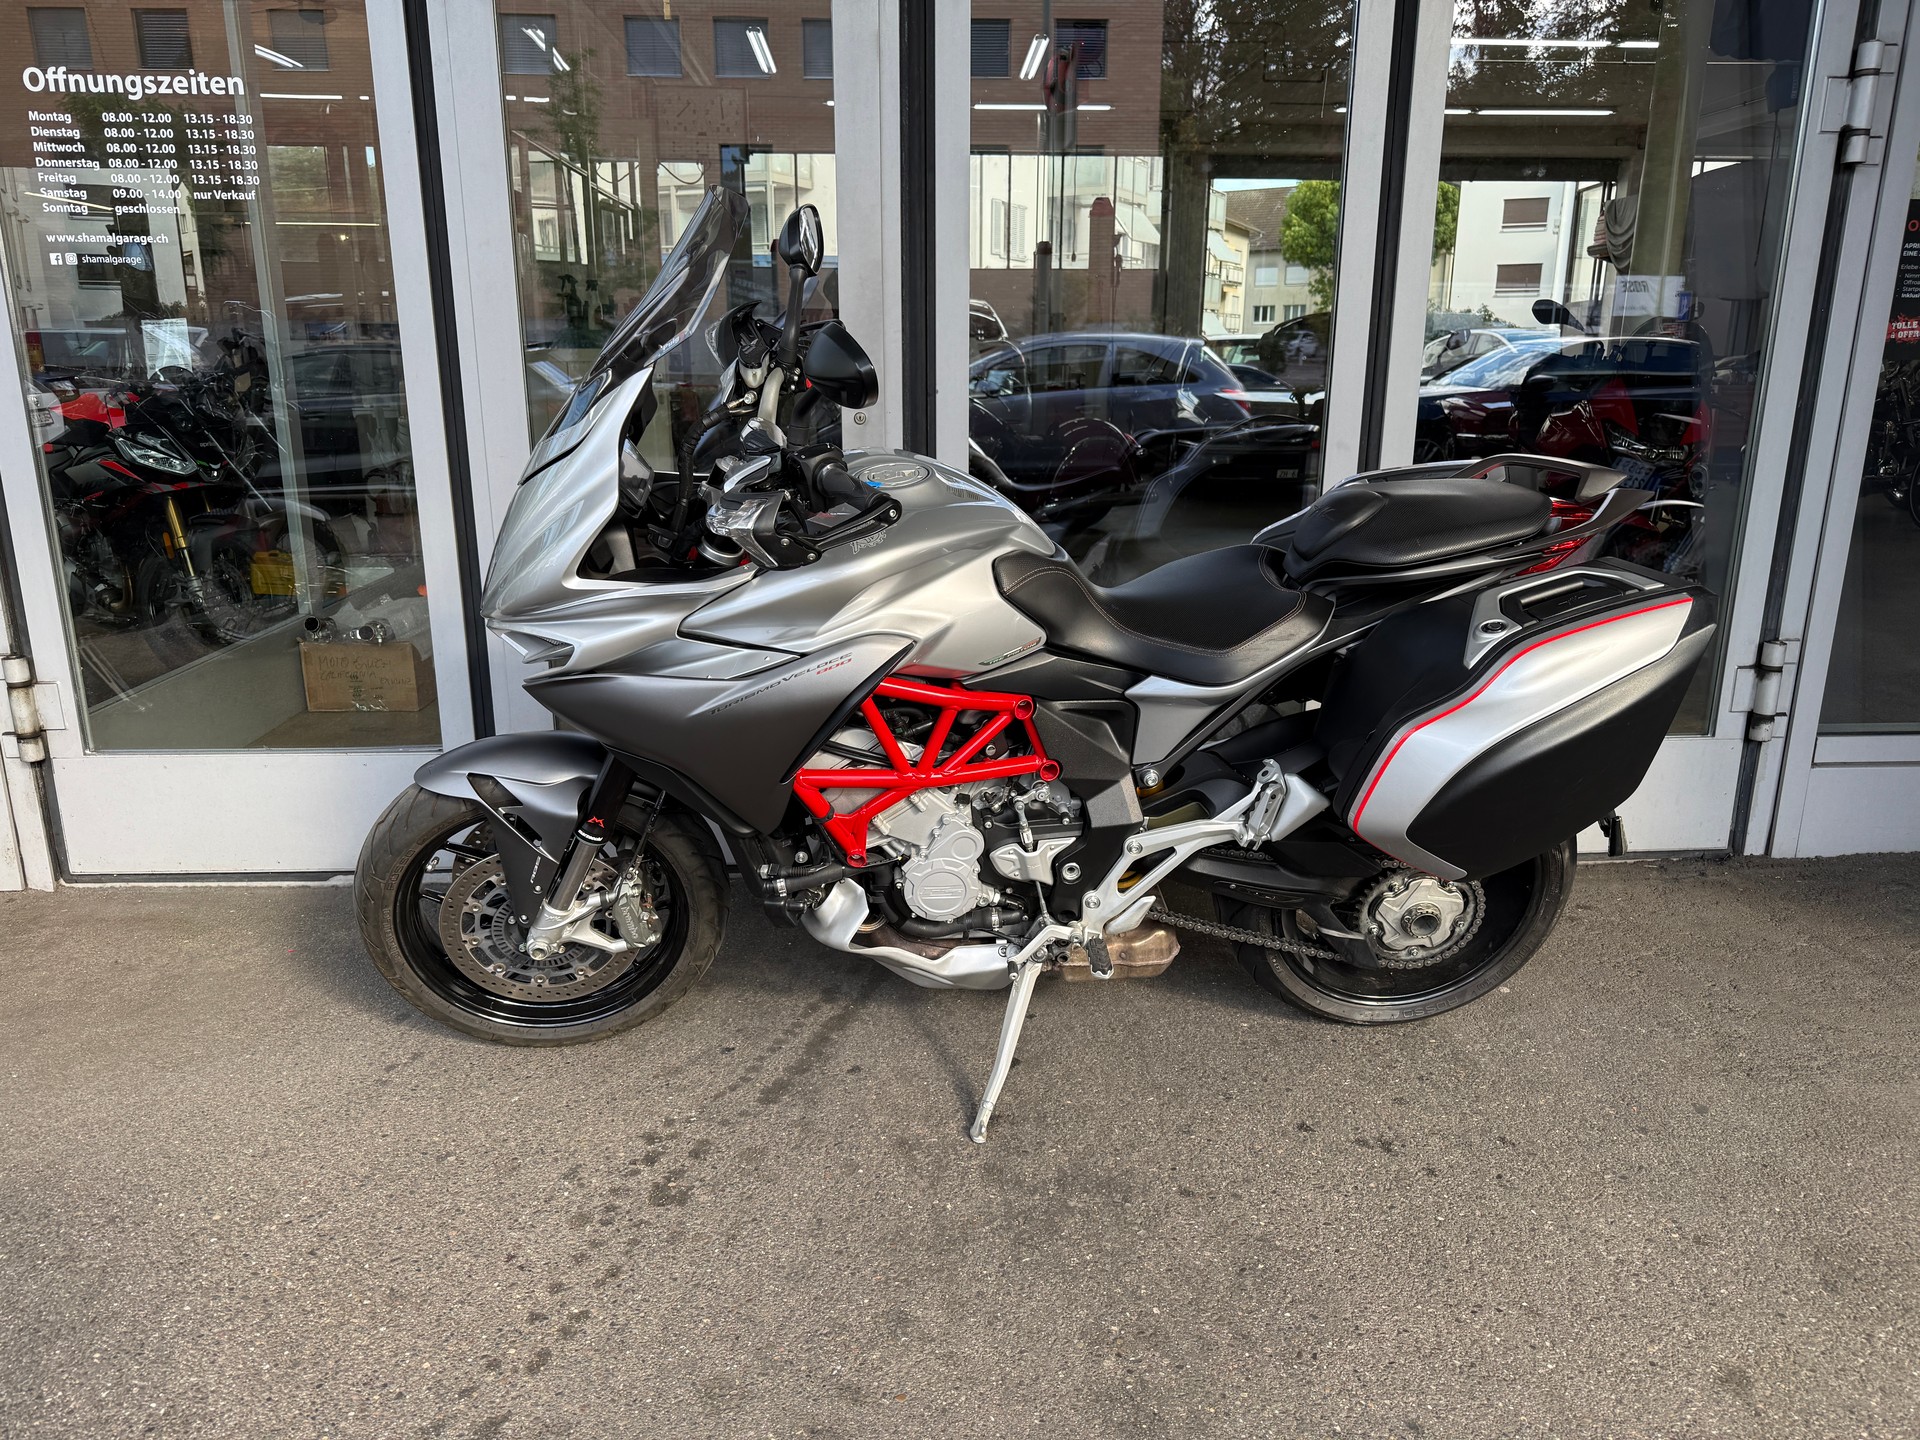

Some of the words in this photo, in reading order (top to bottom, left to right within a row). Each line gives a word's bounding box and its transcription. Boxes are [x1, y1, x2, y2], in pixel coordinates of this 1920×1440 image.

[28, 111, 72, 124] Montag
[102, 113, 133, 123] 08.00
[141, 113, 172, 124] 12.00
[184, 113, 214, 124] 13.15
[222, 114, 253, 125] 18.30
[30, 126, 81, 139] Dienstag
[104, 128, 135, 138] 08.00
[143, 128, 174, 139] 12.00
[186, 129, 215, 139] 13.15
[224, 130, 255, 140] 18.30
[33, 141, 85, 153] Mittwoch
[106, 143, 137, 153] 08.00
[145, 143, 176, 154] 12.00
[188, 144, 218, 155] 13.15
[226, 145, 257, 155] 18.30
[35, 156, 100, 171] Donnerstag
[108, 158, 139, 169] 08.00
[148, 158, 178, 169] 12.00
[189, 160, 219, 170] 13.15
[228, 160, 258, 171] 18.30
[38, 172, 77, 185] Freitag
[110, 173, 141, 184] 08.00
[150, 174, 180, 184] 12.00
[191, 175, 221, 185] 13.15
[230, 175, 260, 186] 18.30
[40, 187, 88, 200] Samstag
[112, 188, 143, 199] 09.00
[151, 189, 182, 199] 14.00
[193, 191, 213, 200] nur
[214, 189, 256, 201] Verkauf
[42, 202, 89, 215] Sonntag
[115, 203, 181, 215] geschlossen
[46, 233, 169, 245] www.shamalgarage.ch
[81, 255, 142, 266] shamalgarage
[1891, 320, 1919, 330] TOLLE
[385, 849, 416, 891] ROSSO
[1402, 996, 1459, 1018] ROSSO
